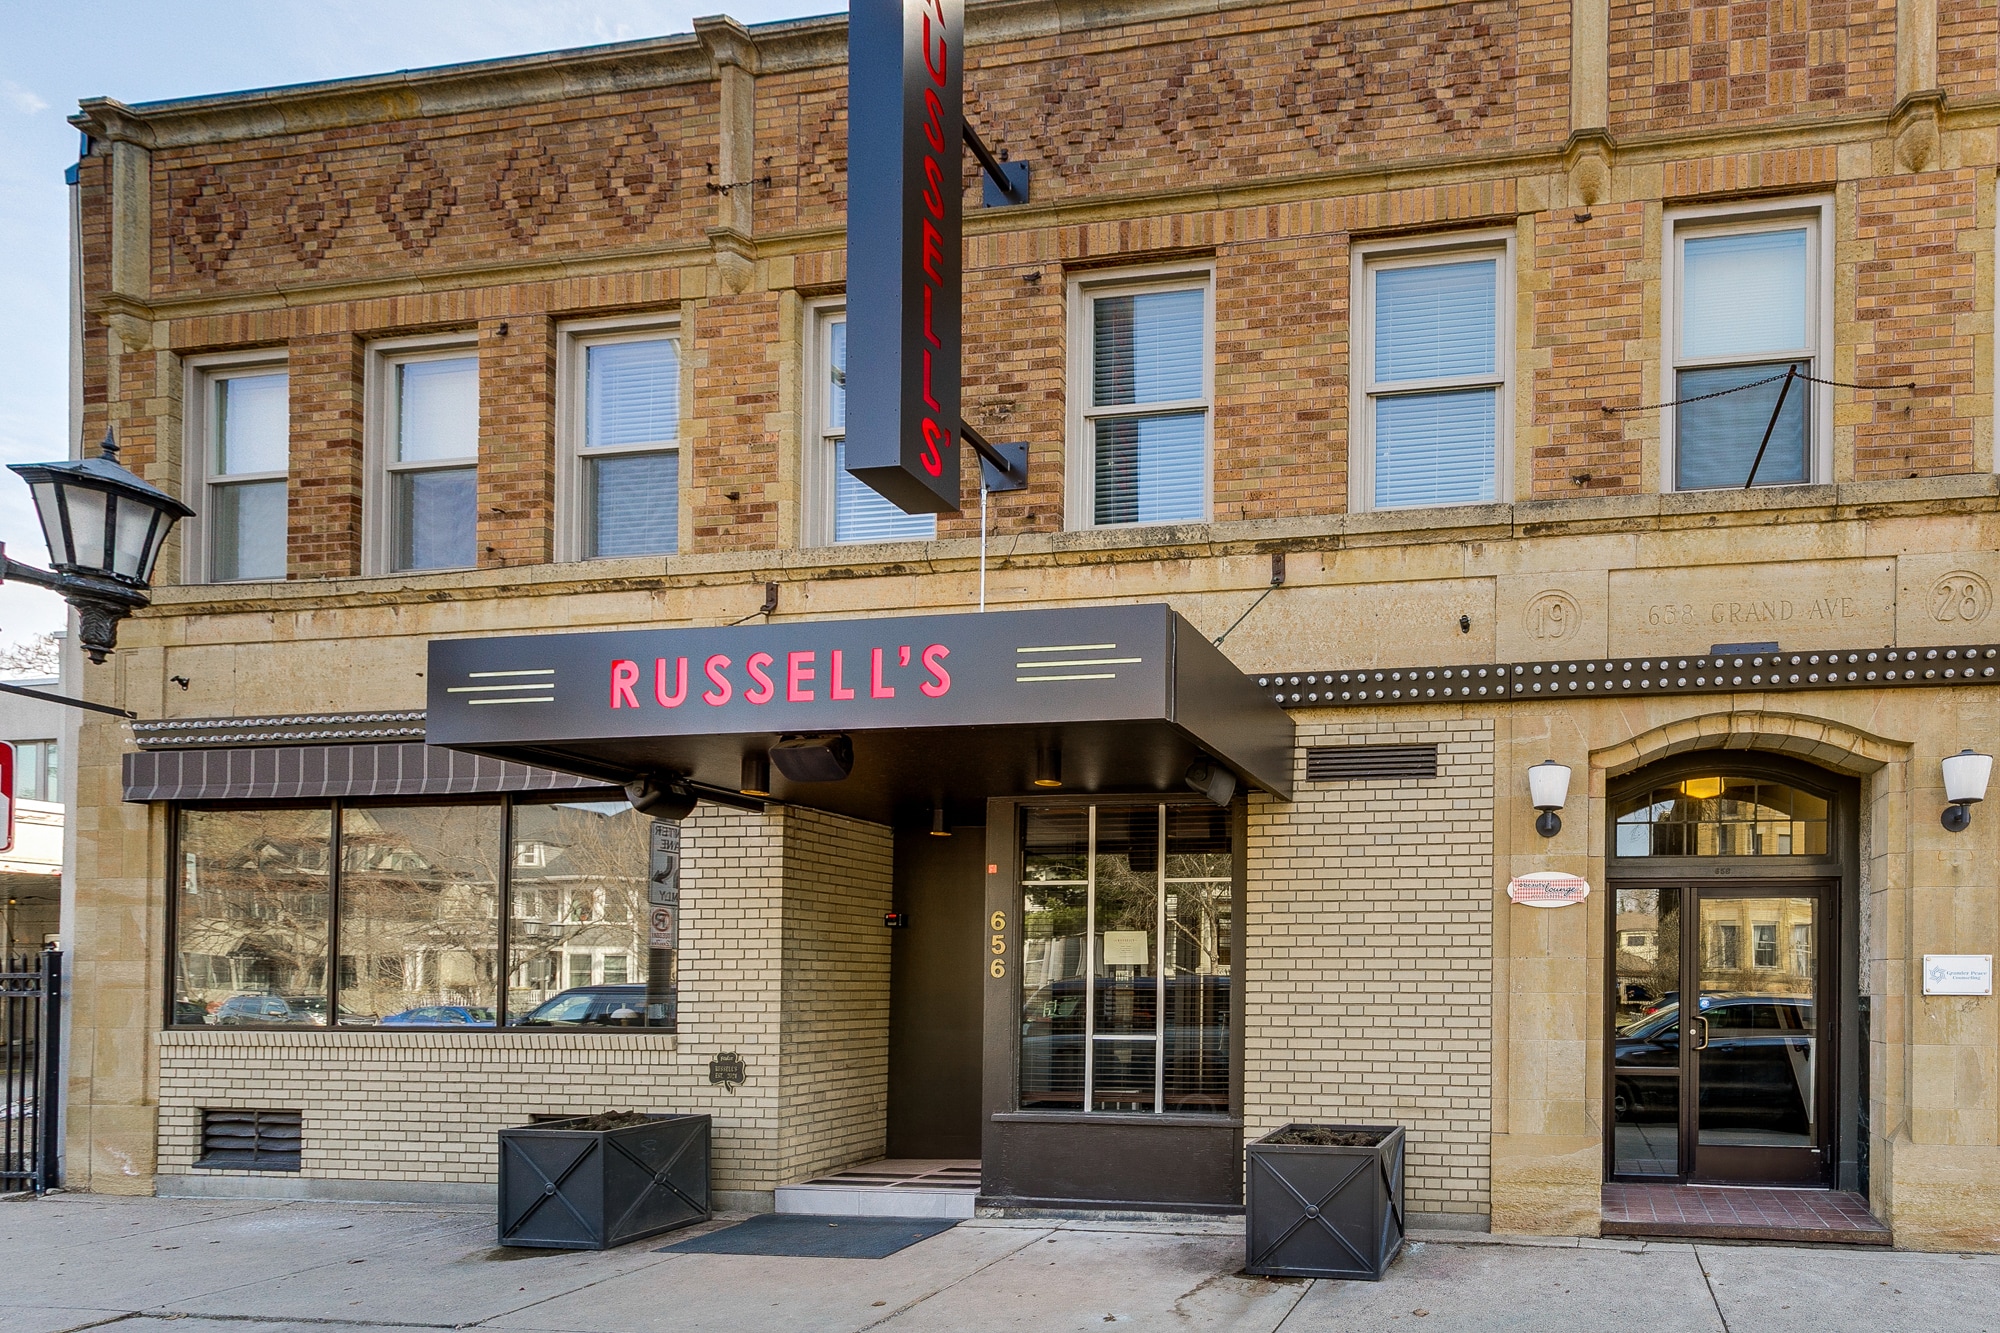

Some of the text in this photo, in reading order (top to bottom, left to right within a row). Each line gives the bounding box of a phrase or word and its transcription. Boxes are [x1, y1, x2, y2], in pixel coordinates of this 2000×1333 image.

[1534, 601, 1568, 639] 19
[1711, 599, 1793, 624] GRAND
[1809, 597, 1855, 620] AVE
[1938, 584, 1976, 622] 28
[610, 643, 951, 708] RUSSELL'S
[990, 910, 1006, 979] 656
